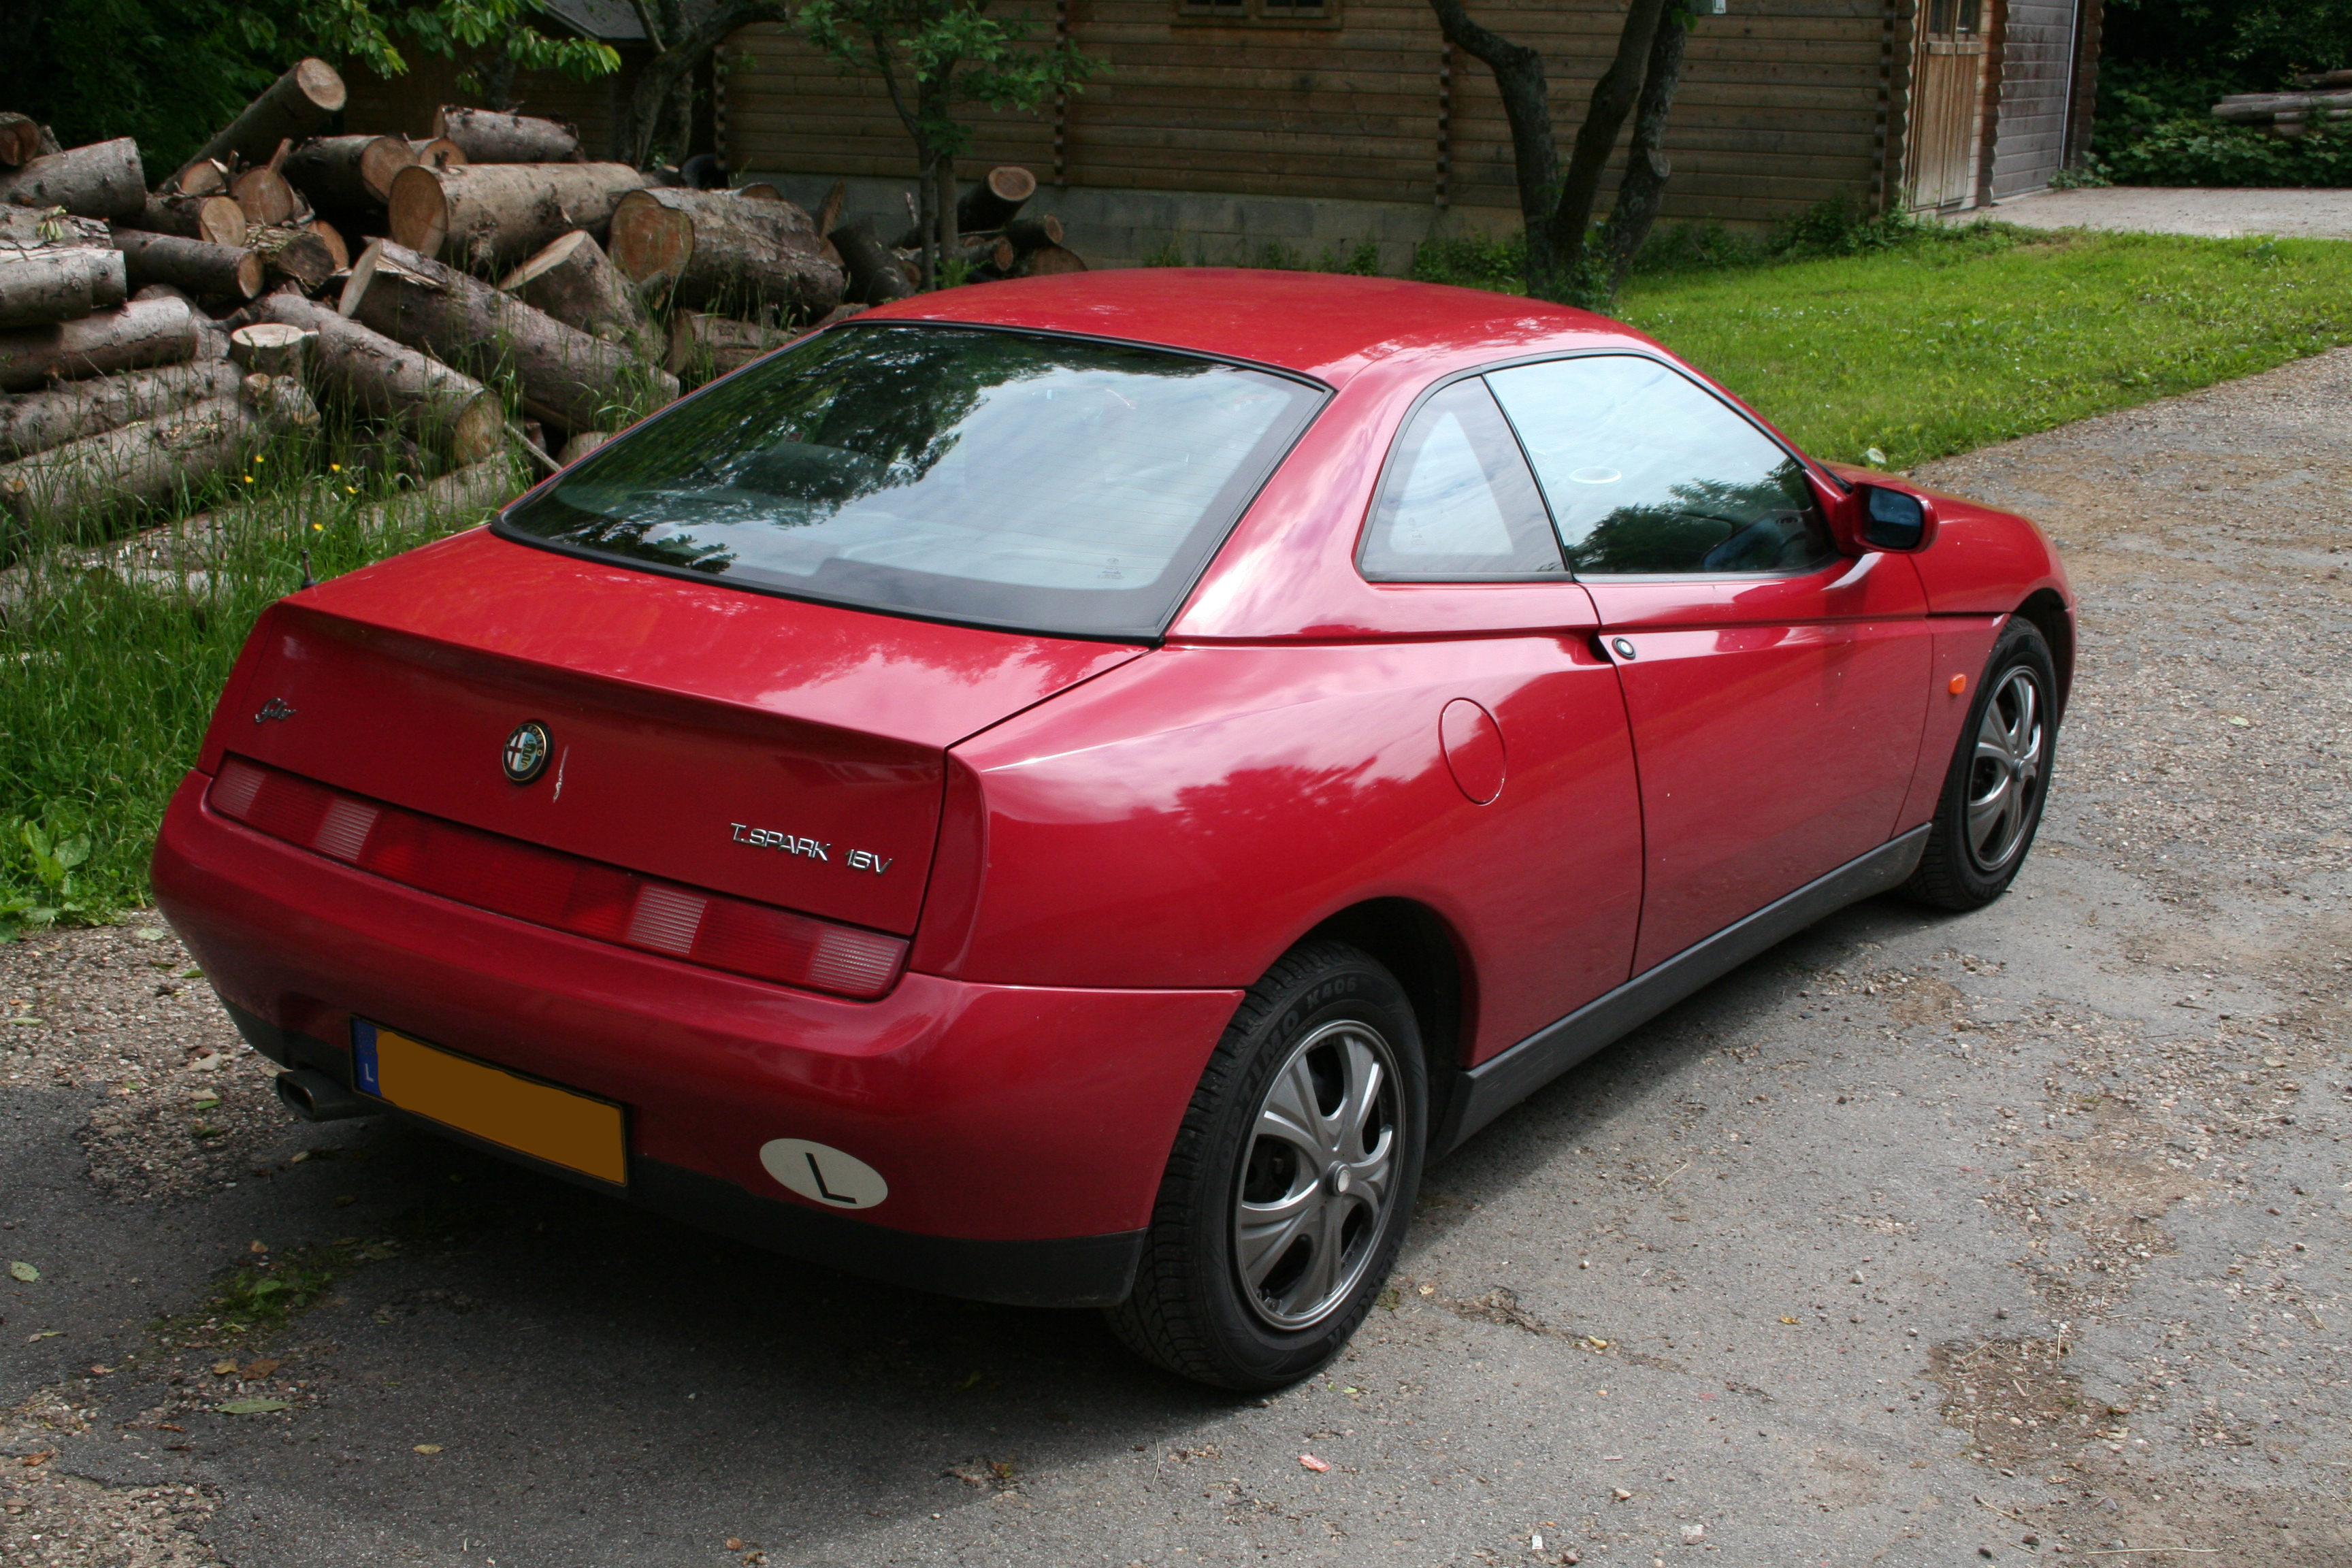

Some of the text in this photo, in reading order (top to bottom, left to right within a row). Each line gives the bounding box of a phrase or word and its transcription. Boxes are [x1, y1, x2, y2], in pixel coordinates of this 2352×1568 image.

[731, 822, 893, 875] T.SPARK 16V
[365, 1062, 374, 1083] L
[1218, 976, 1357, 1170] OPTIMO K406
[805, 1152, 858, 1204] L
